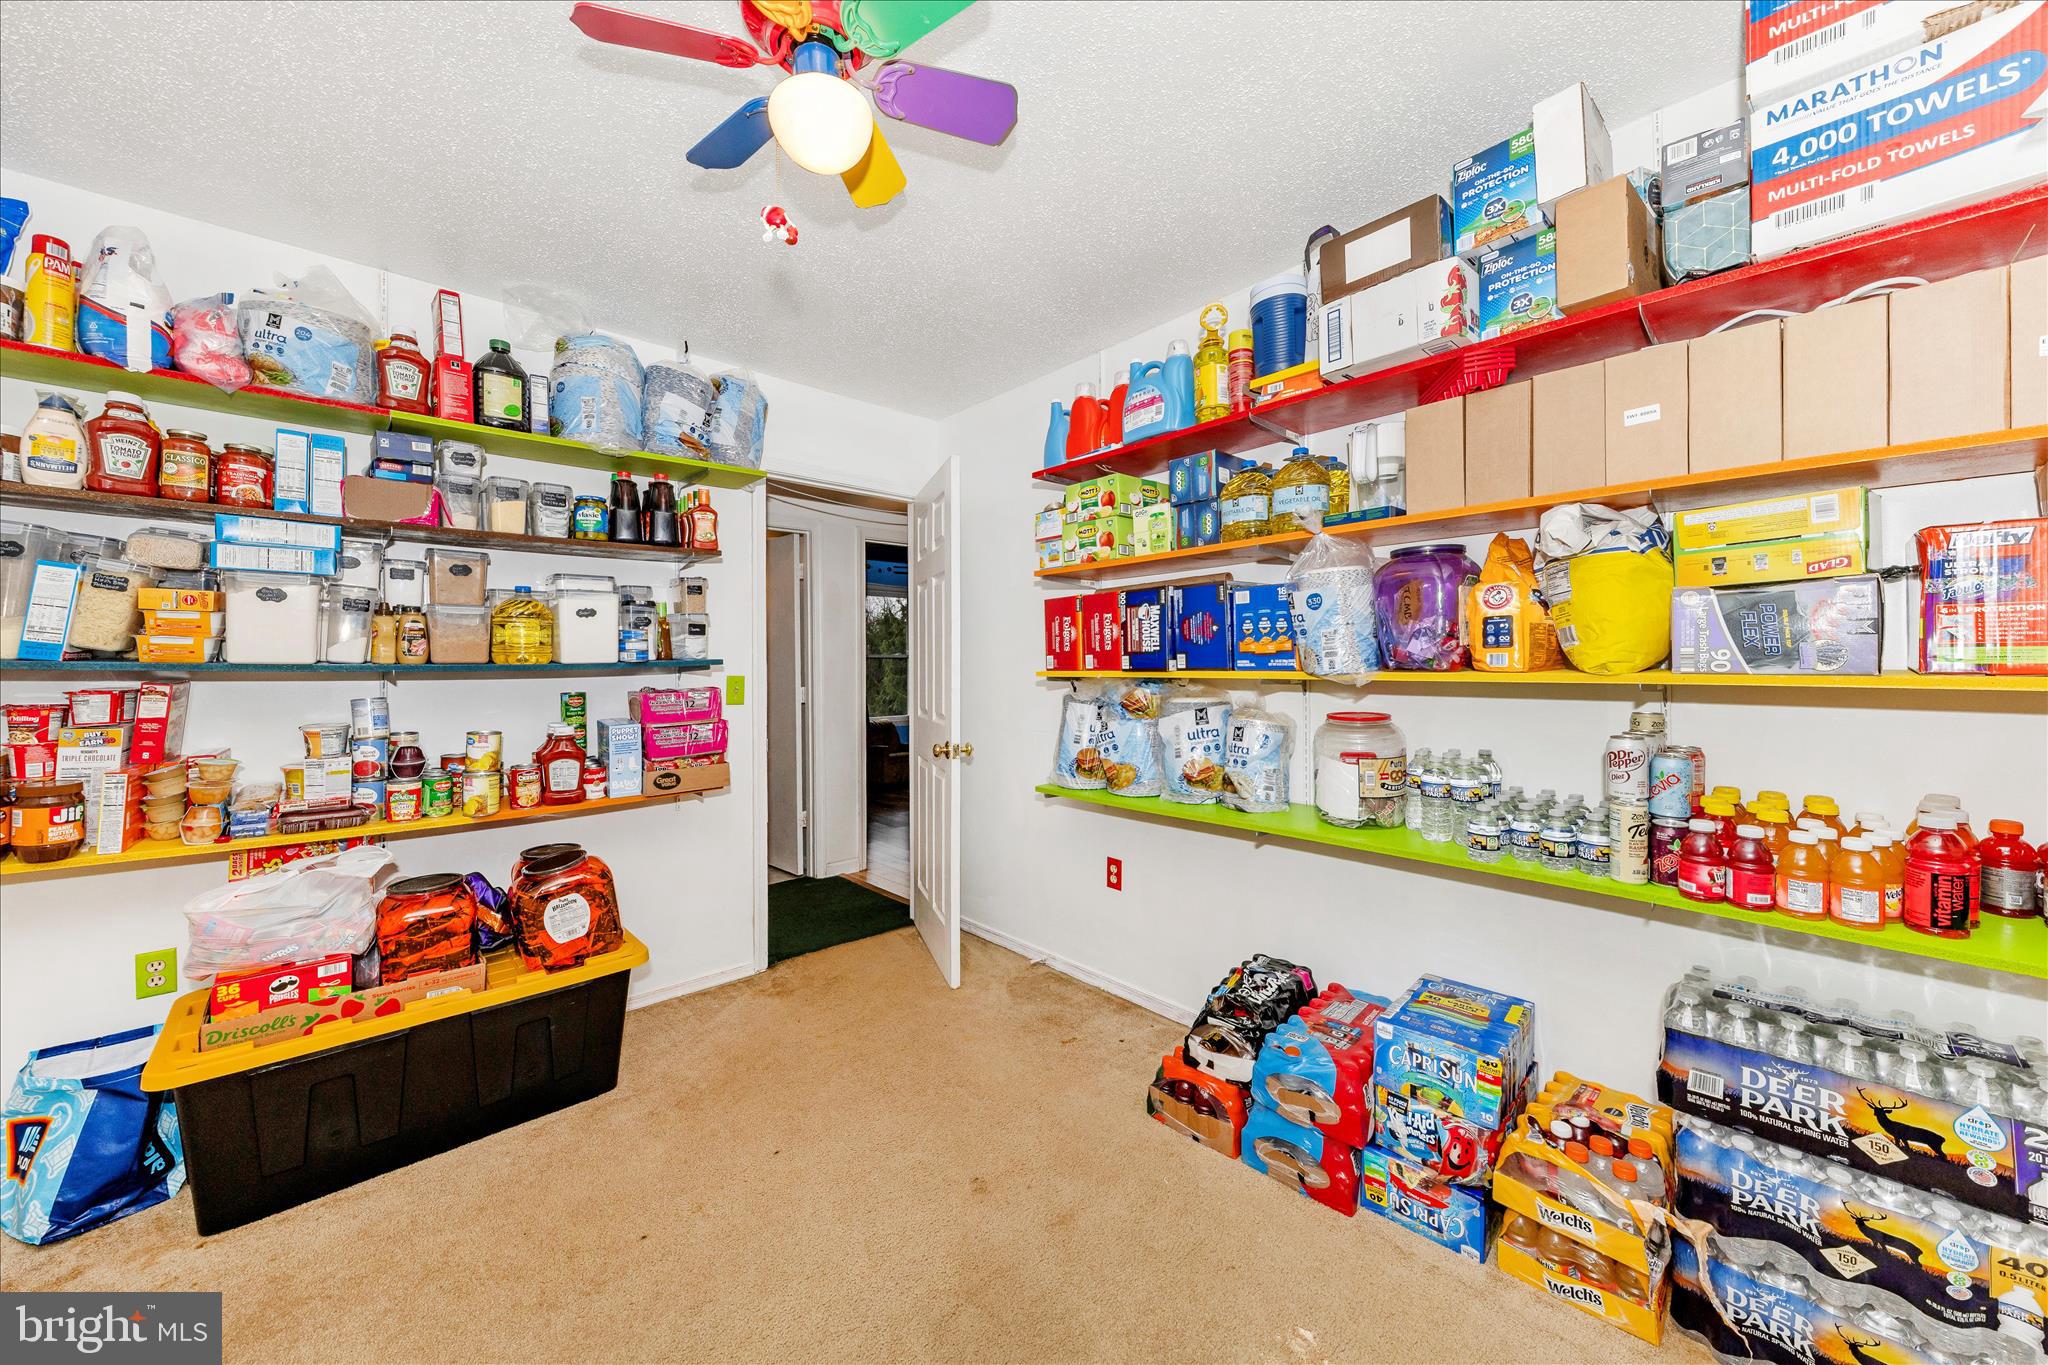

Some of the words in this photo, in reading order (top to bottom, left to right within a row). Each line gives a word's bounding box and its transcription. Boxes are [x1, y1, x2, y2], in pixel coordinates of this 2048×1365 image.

[1766, 43, 1944, 126] MARATHON
[1838, 95, 1859, 110] THAT
[1860, 86, 1882, 98] GOES
[1883, 79, 1898, 91] THE
[1900, 63, 1943, 83] DISTANCE
[1772, 122, 1858, 166] 4,000
[1457, 163, 1487, 182] Ziploc
[1768, 156, 1881, 202] MULTI-FOLD
[1886, 124, 1976, 162] TOWELS
[1462, 165, 1529, 200] PROTECTION
[1474, 165, 1515, 186] ON-THE-GO
[1486, 203, 1504, 215] 3X
[1538, 232, 1556, 246] 58
[44, 256, 71, 276] PAM
[1484, 257, 1514, 275] Ziploc
[1501, 261, 1541, 279] ON-THE-GO
[1488, 263, 1556, 292] PROTECTION
[1513, 299, 1530, 310] 3X
[255, 329, 287, 345] ultra
[110, 444, 142, 455] TOMATO
[115, 438, 138, 447] HEINZ
[111, 450, 141, 459] KETCHUP
[165, 453, 206, 466] CLASSICO
[1808, 556, 1849, 573] GLAD
[1277, 586, 1287, 595] 18
[1307, 596, 1321, 606] 330
[1062, 616, 1071, 652] Folgers
[1103, 613, 1113, 651] Folgers
[1142, 620, 1151, 652] HOUSE
[1150, 605, 1161, 651] MAXWELL
[1739, 611, 1761, 648] FLEX
[1760, 603, 1782, 656] POWER
[1699, 631, 1709, 651] Trash
[1699, 652, 1709, 673] Bags
[1710, 649, 1731, 673] 90
[611, 727, 638, 735] PUPPET
[611, 733, 638, 741] SHOW!
[689, 732, 699, 740] 12
[1187, 727, 1220, 741] ultra
[1607, 751, 1644, 770] Pepper
[1617, 750, 1634, 760] Dr
[656, 776, 677, 784] Great
[1611, 772, 1625, 781] Diet
[53, 805, 84, 823] Jif
[1932, 875, 1952, 927] vitamin
[1952, 876, 1964, 912] water
[216, 983, 240, 997] 36
[217, 993, 240, 1003] CUPS
[269, 989, 299, 1004] PRINGLES
[206, 1015, 297, 1046] Driscoll's
[1389, 1040, 1437, 1074] CAPRI
[1439, 1060, 1478, 1094] SUN
[1763, 1066, 1779, 1075] EST.
[1800, 1077, 1818, 1085] 1873
[1741, 1066, 1848, 1116] DEER
[1740, 1086, 1849, 1138] PARK
[1740, 1109, 1758, 1120] 100%
[1759, 1114, 1792, 1131] NATURAL
[1794, 1125, 1821, 1140] SPRING
[1822, 1134, 1849, 1148] WATER
[1959, 1122, 1999, 1137] HYDRATE
[1868, 1140, 1890, 1154] 150
[1369, 1193, 1383, 1203] 40
[1731, 1168, 1821, 1220] DEER
[1414, 1206, 1465, 1238] CAPRI
[1539, 1206, 1593, 1234] Welch's
[1731, 1186, 1821, 1238] PARK
[1730, 1204, 1747, 1215] 100%
[1748, 1208, 1776, 1222] NATURAL
[1777, 1218, 1801, 1233] SPRING
[1802, 1230, 1823, 1247] WATER
[1837, 1252, 1857, 1266] 150
[1997, 1256, 2048, 1279] 40
[1999, 1270, 2016, 1281] 0.5
[2018, 1277, 2047, 1292] LITER
[1546, 1278, 1603, 1307] Welch's
[1726, 1285, 1815, 1344] DEER
[1726, 1302, 1815, 1360] PARK
[1741, 1326, 1771, 1341] NATURAL
[1771, 1337, 1796, 1355] SPRING
